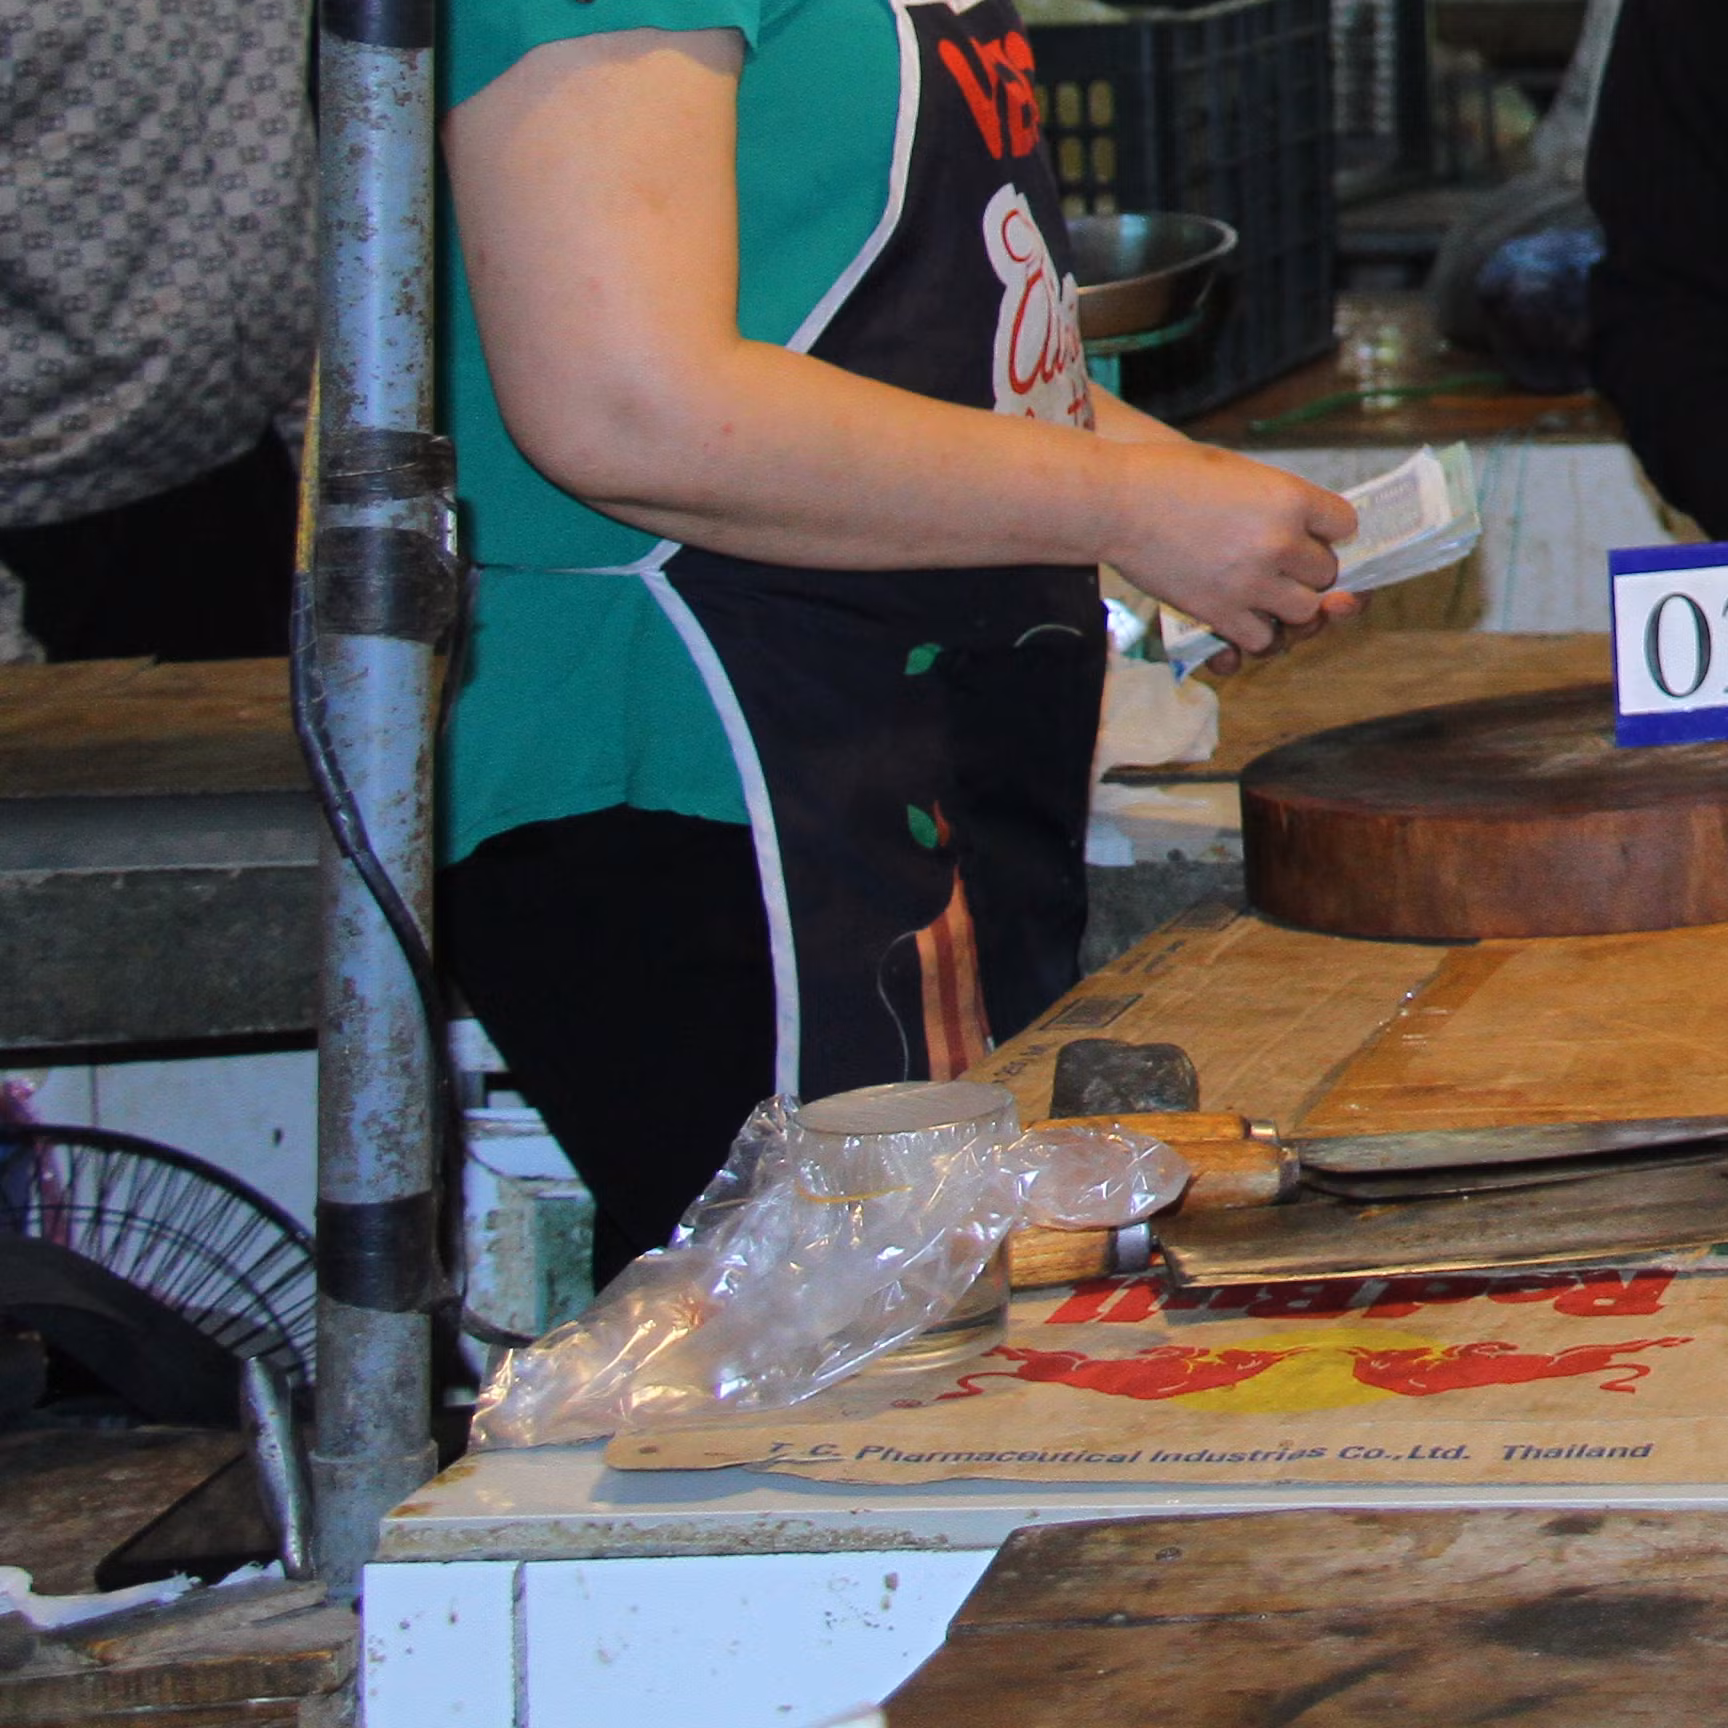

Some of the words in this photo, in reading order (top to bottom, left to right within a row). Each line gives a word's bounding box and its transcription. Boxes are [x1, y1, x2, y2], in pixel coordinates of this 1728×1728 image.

[855, 1444, 1141, 1465] Pharmaceutical
[1149, 1442, 1328, 1464] Industries
[1501, 1442, 1655, 1461] Thailand
